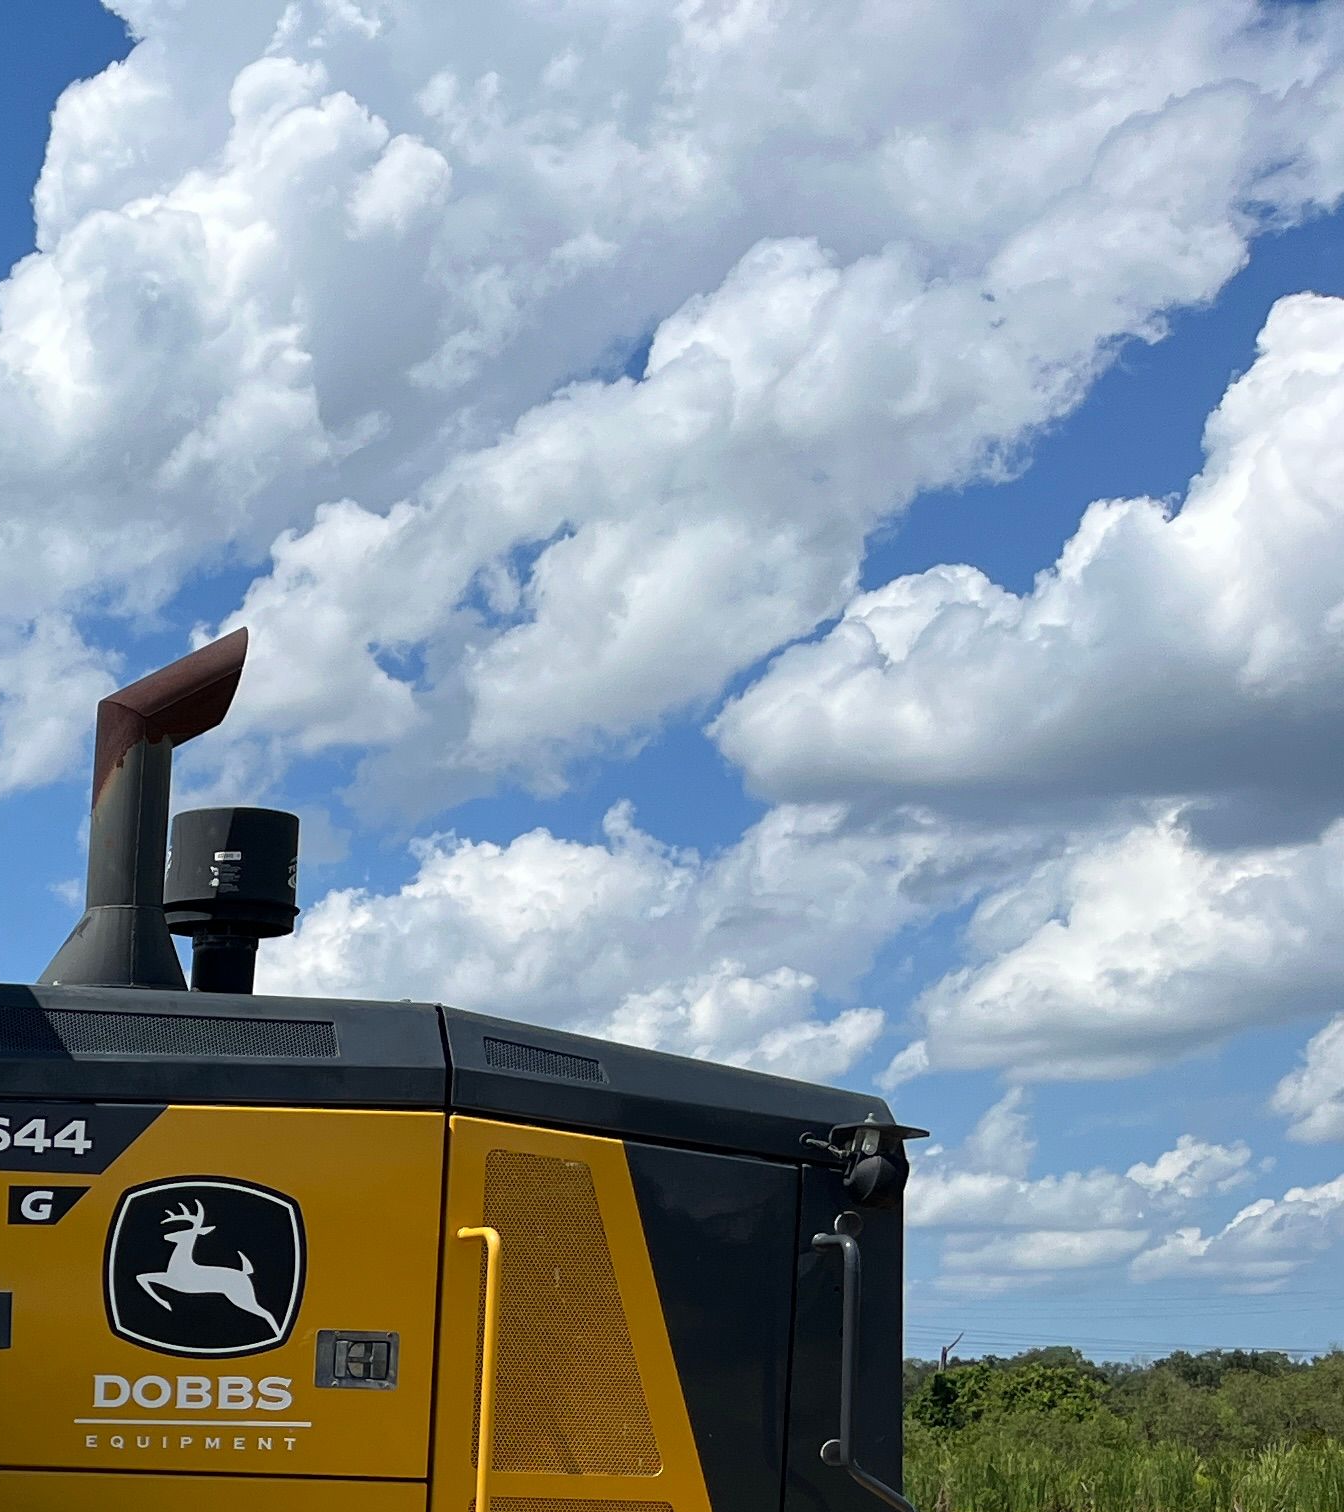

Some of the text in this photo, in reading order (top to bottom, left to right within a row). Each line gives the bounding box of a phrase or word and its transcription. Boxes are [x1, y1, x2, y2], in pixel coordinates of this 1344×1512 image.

[20, 1190, 54, 1221] G
[93, 1374, 293, 1411] DOBBS
[85, 1435, 297, 1451] EQUIPMENT
